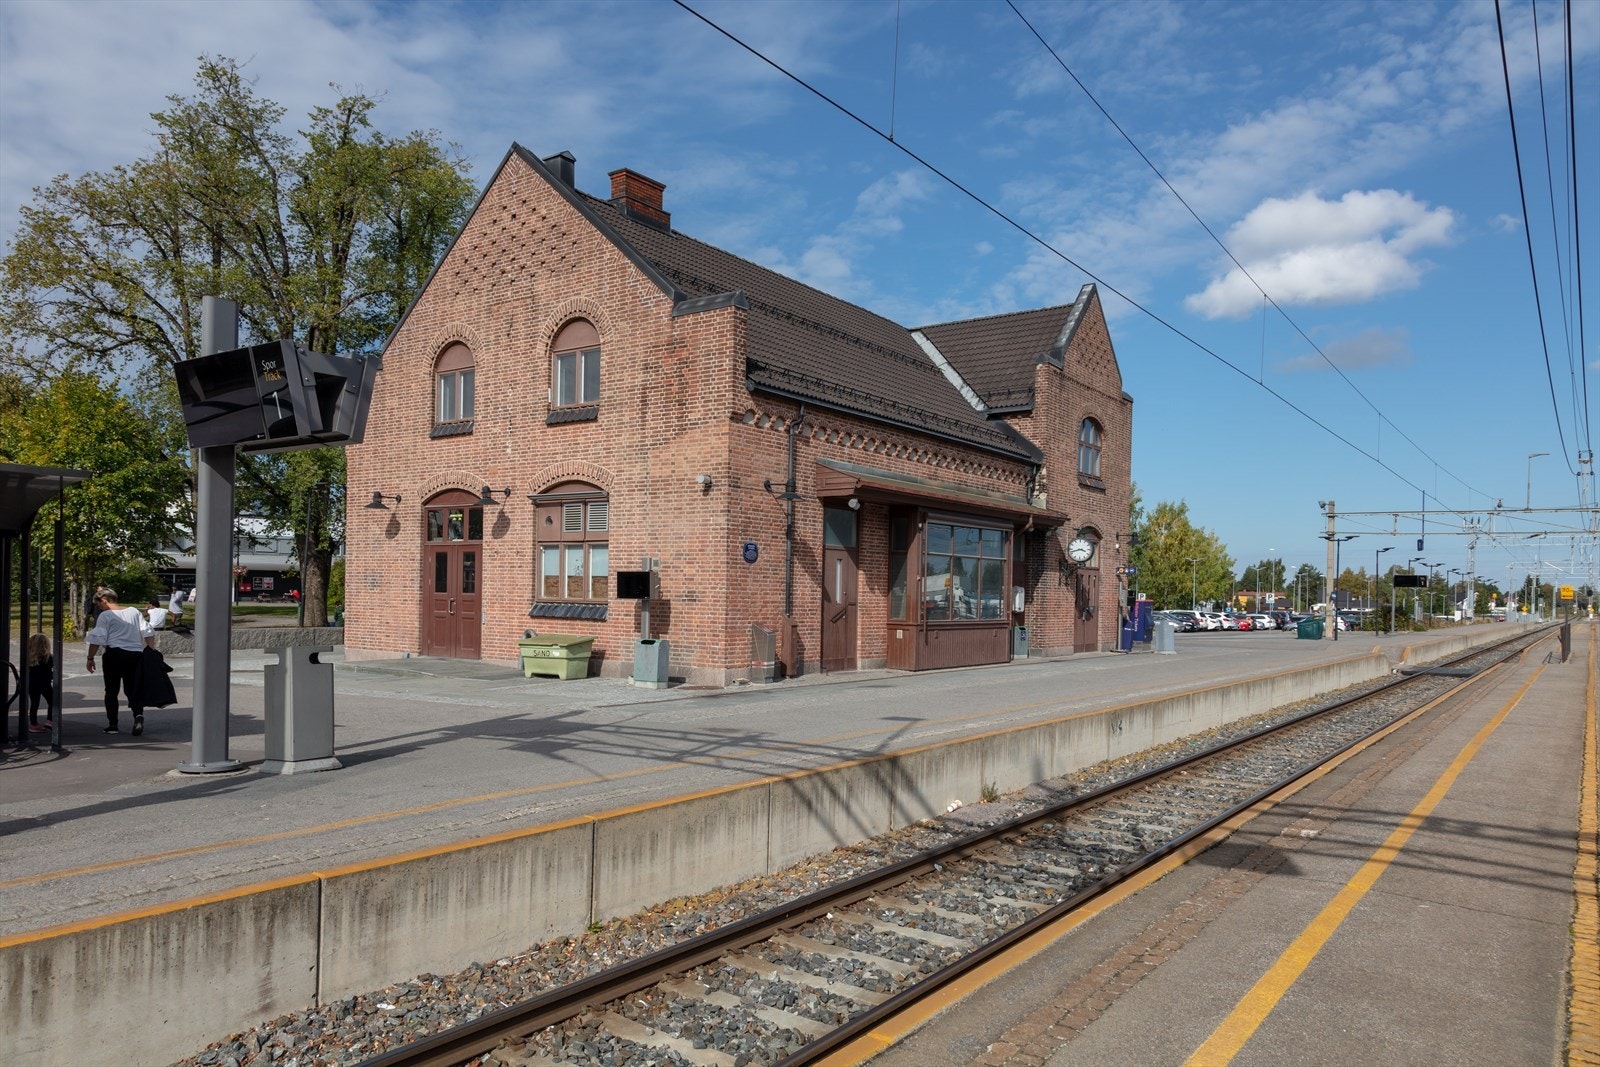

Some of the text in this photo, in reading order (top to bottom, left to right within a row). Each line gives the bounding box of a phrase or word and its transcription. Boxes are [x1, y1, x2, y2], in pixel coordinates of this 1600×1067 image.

[262, 360, 277, 371] Spor
[264, 370, 281, 382] Track
[272, 391, 282, 419] 1
[533, 649, 550, 657] SAND
